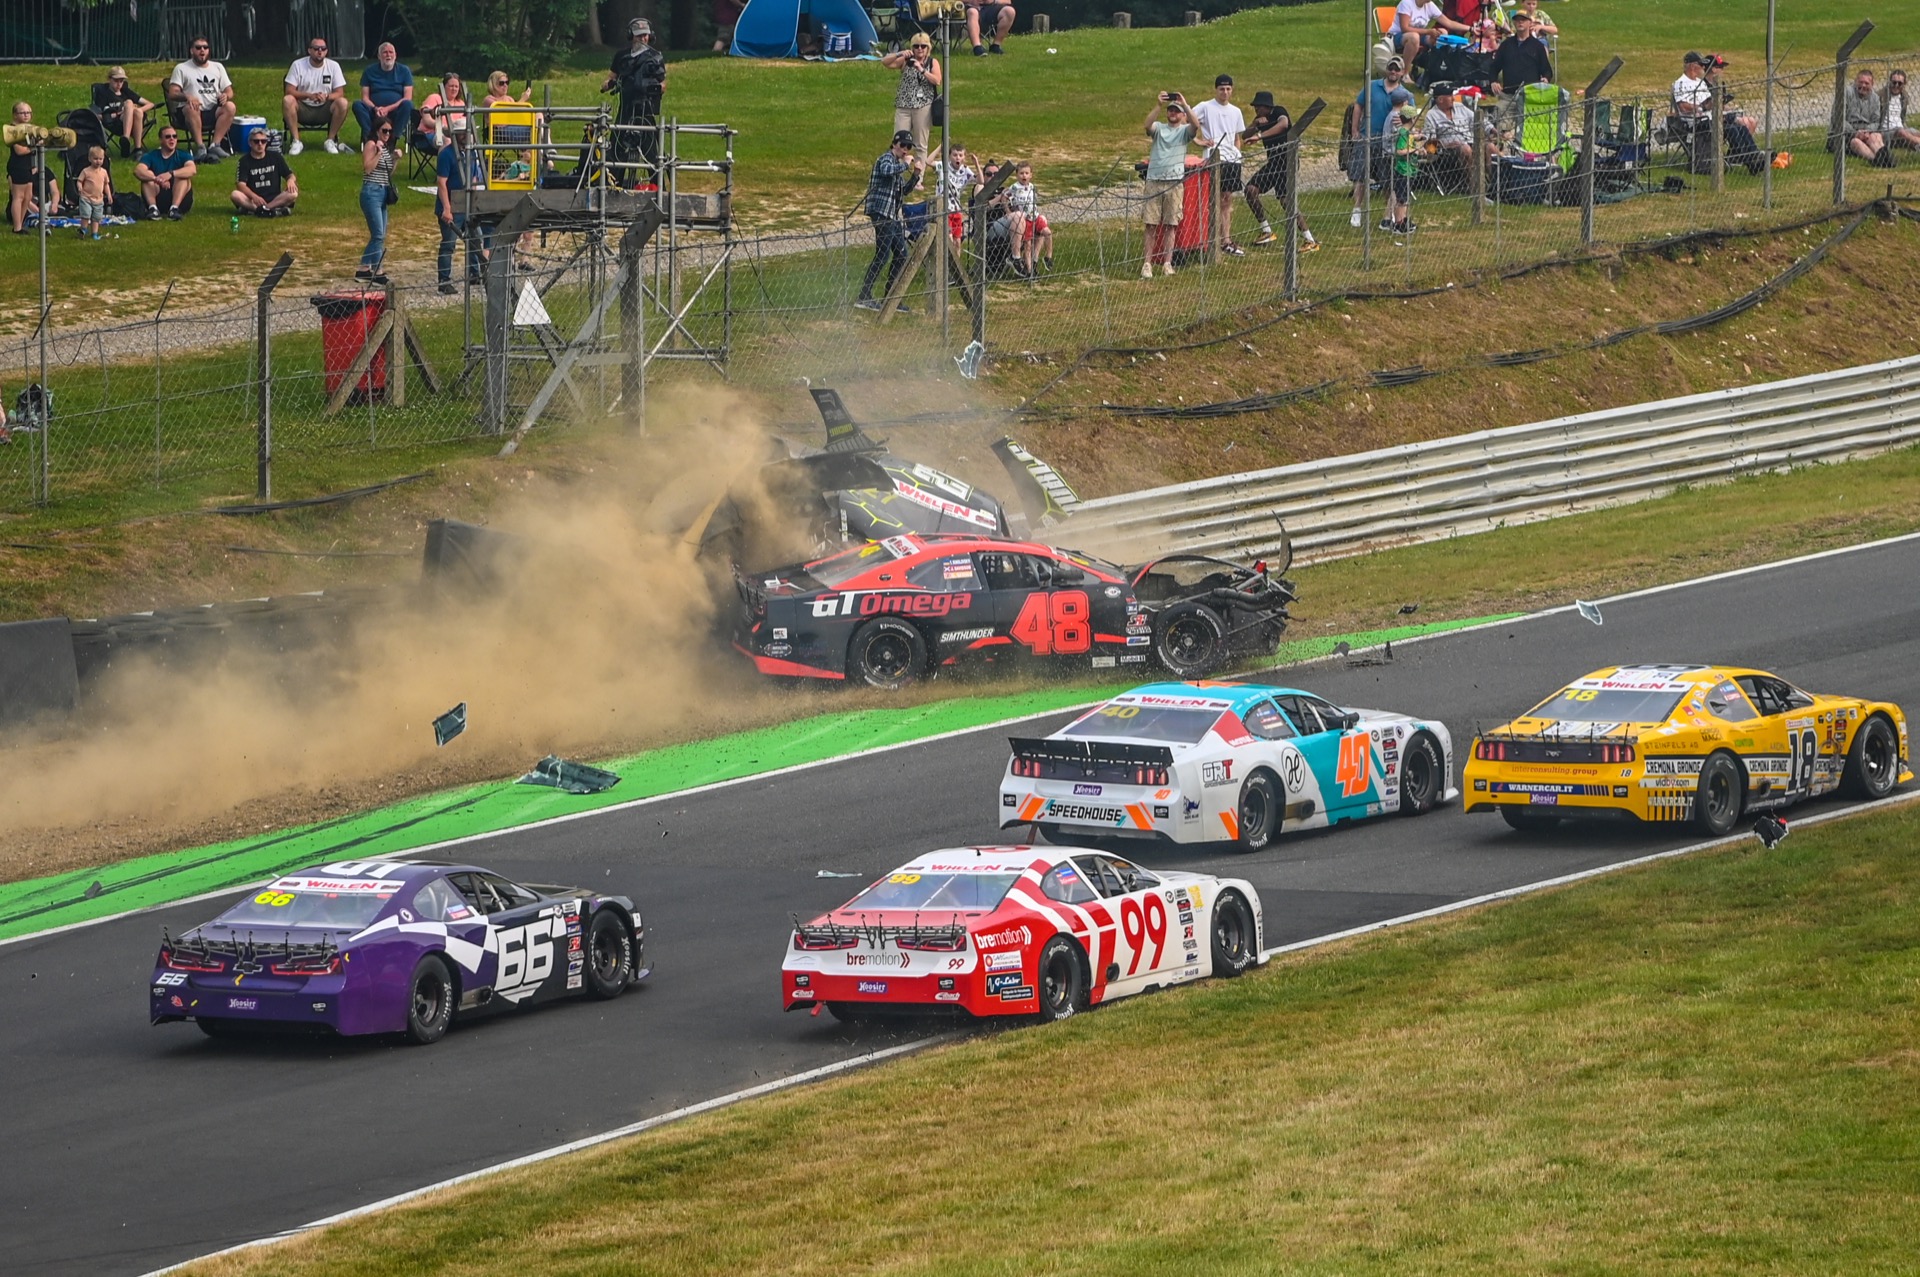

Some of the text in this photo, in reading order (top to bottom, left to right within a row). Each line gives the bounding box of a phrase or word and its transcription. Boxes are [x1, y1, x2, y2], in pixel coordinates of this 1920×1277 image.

[899, 482, 970, 517] WHELEN
[812, 591, 859, 618] GT
[1010, 590, 1091, 656] 48
[941, 627, 995, 642] SIMTHUNDER
[1602, 680, 1666, 690] WHELEN
[1141, 696, 1207, 706] WHELEN
[1563, 690, 1599, 701] 18
[1100, 706, 1140, 718] 40
[1335, 732, 1371, 798] 40
[1646, 761, 1675, 773] CREMONA
[1750, 760, 1769, 772] CREMONA
[1784, 728, 1818, 796] 18
[1512, 765, 1598, 776] interconsulting.group
[1620, 768, 1632, 778] 18
[1076, 786, 1102, 794] Hoosier
[1154, 789, 1172, 800] 40
[1508, 784, 1573, 793] WARNERCAR.IT
[1049, 805, 1123, 821] SPEEDHOUSE
[306, 880, 378, 889] WHELEN
[888, 874, 921, 884] 99
[254, 890, 295, 906] 66
[975, 928, 1024, 949] bremotion
[1120, 892, 1167, 976] 99
[494, 918, 554, 991] 66
[622, 936, 633, 974] Hoosier
[846, 952, 900, 966] bremotion
[948, 958, 965, 970] 99
[156, 972, 188, 985] 66
[858, 982, 886, 992] Hoosier
[228, 999, 256, 1008] Hoosier
